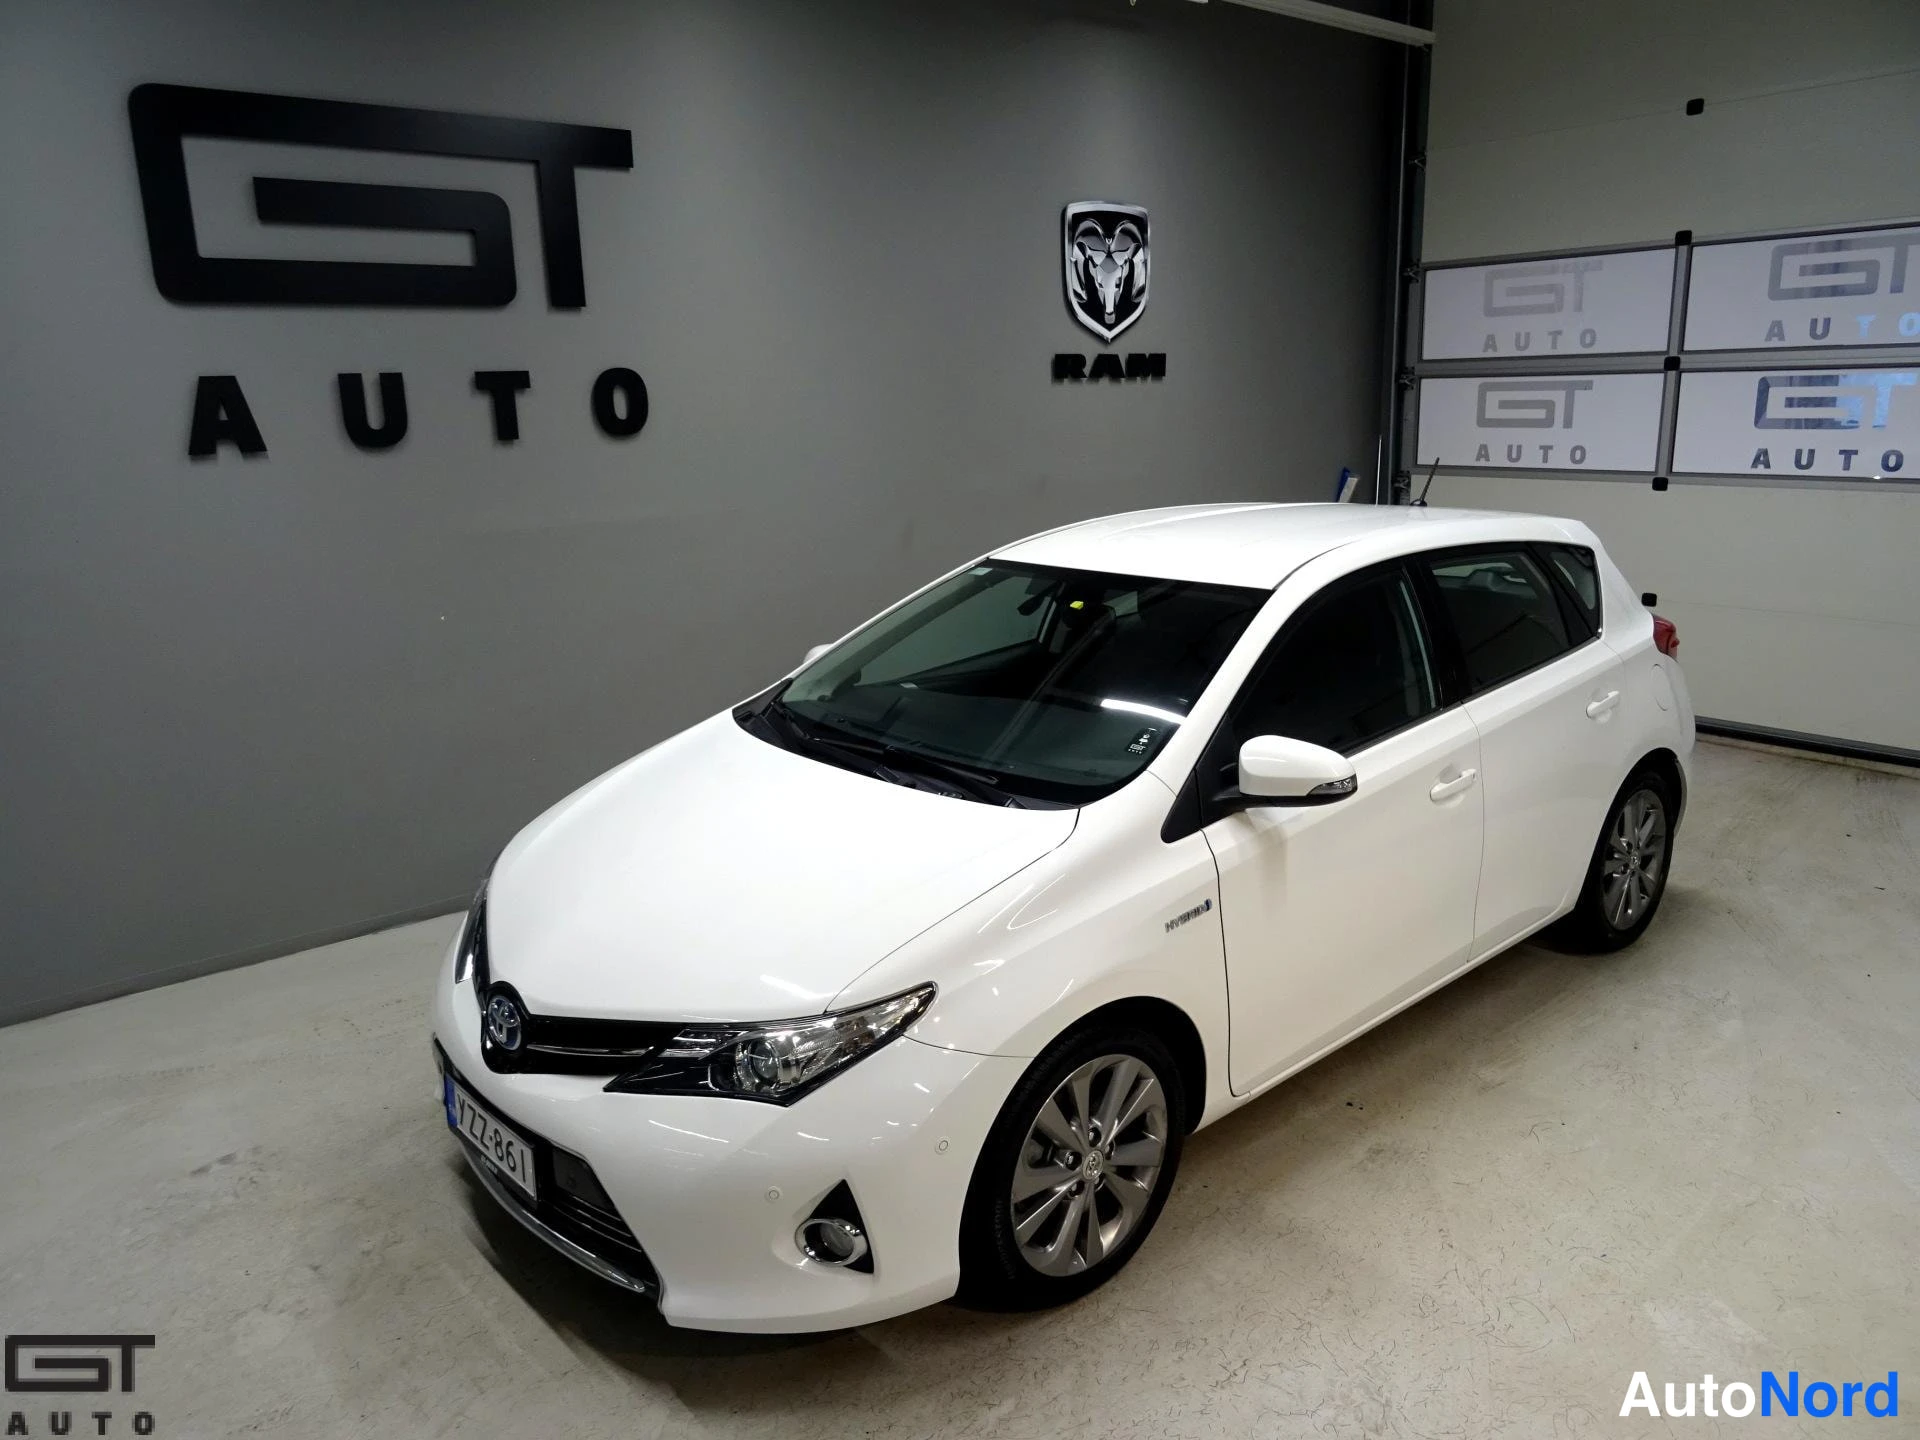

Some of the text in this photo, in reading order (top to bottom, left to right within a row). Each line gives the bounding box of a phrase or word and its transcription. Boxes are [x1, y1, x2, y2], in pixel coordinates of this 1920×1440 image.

[128, 82, 634, 310] GT
[1482, 328, 1597, 353] AUTO
[1764, 312, 1920, 342] AUTO
[1053, 353, 1167, 380] RAM
[188, 367, 649, 458] AUTO
[1475, 443, 1587, 465] AUTO
[1751, 448, 1904, 472] AUTO
[457, 1093, 526, 1183] YZZ-861
